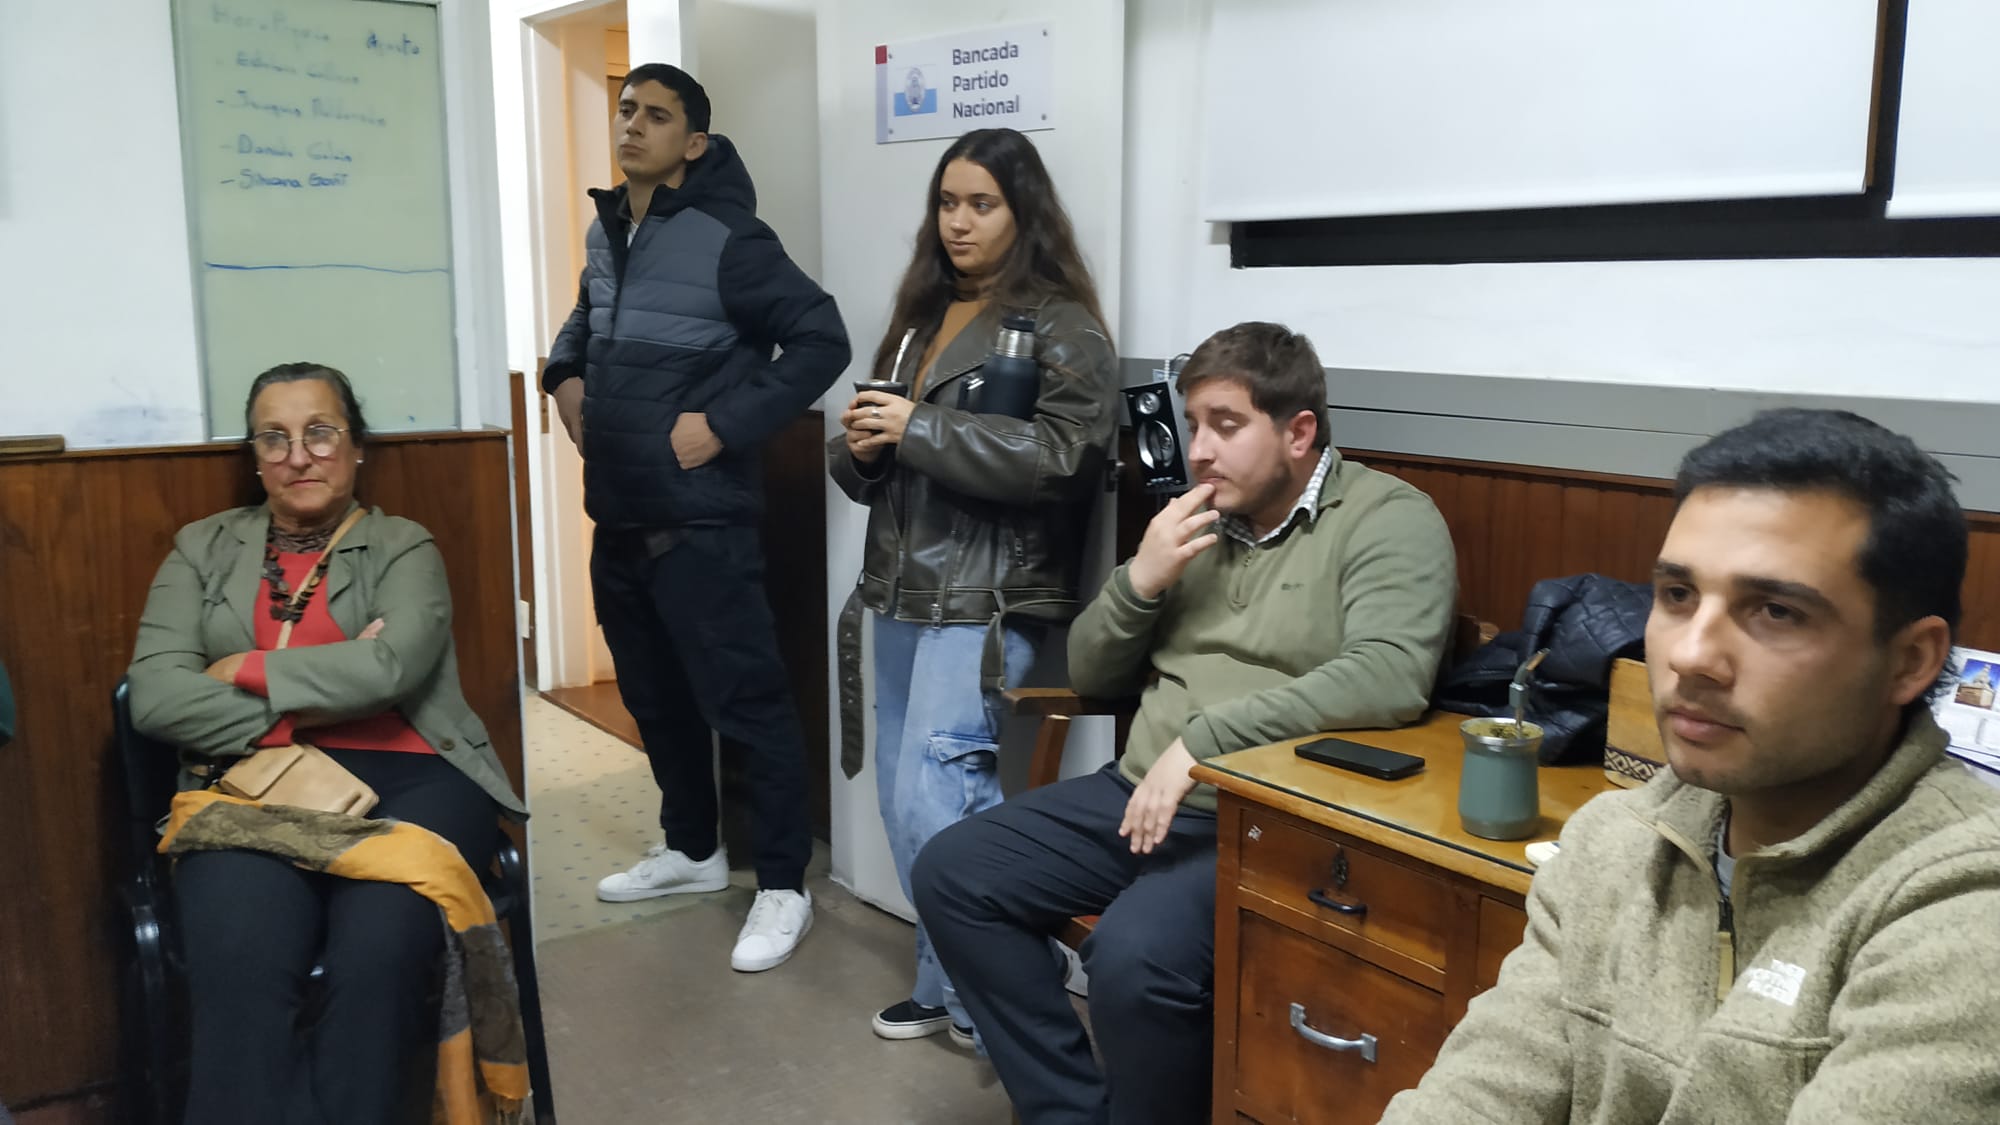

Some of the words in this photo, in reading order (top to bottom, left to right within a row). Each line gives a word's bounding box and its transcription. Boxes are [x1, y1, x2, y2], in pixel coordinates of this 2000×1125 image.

[952, 41, 1019, 65] Bancada
[952, 70, 1009, 92] Partido
[952, 95, 1020, 119] Nacional
